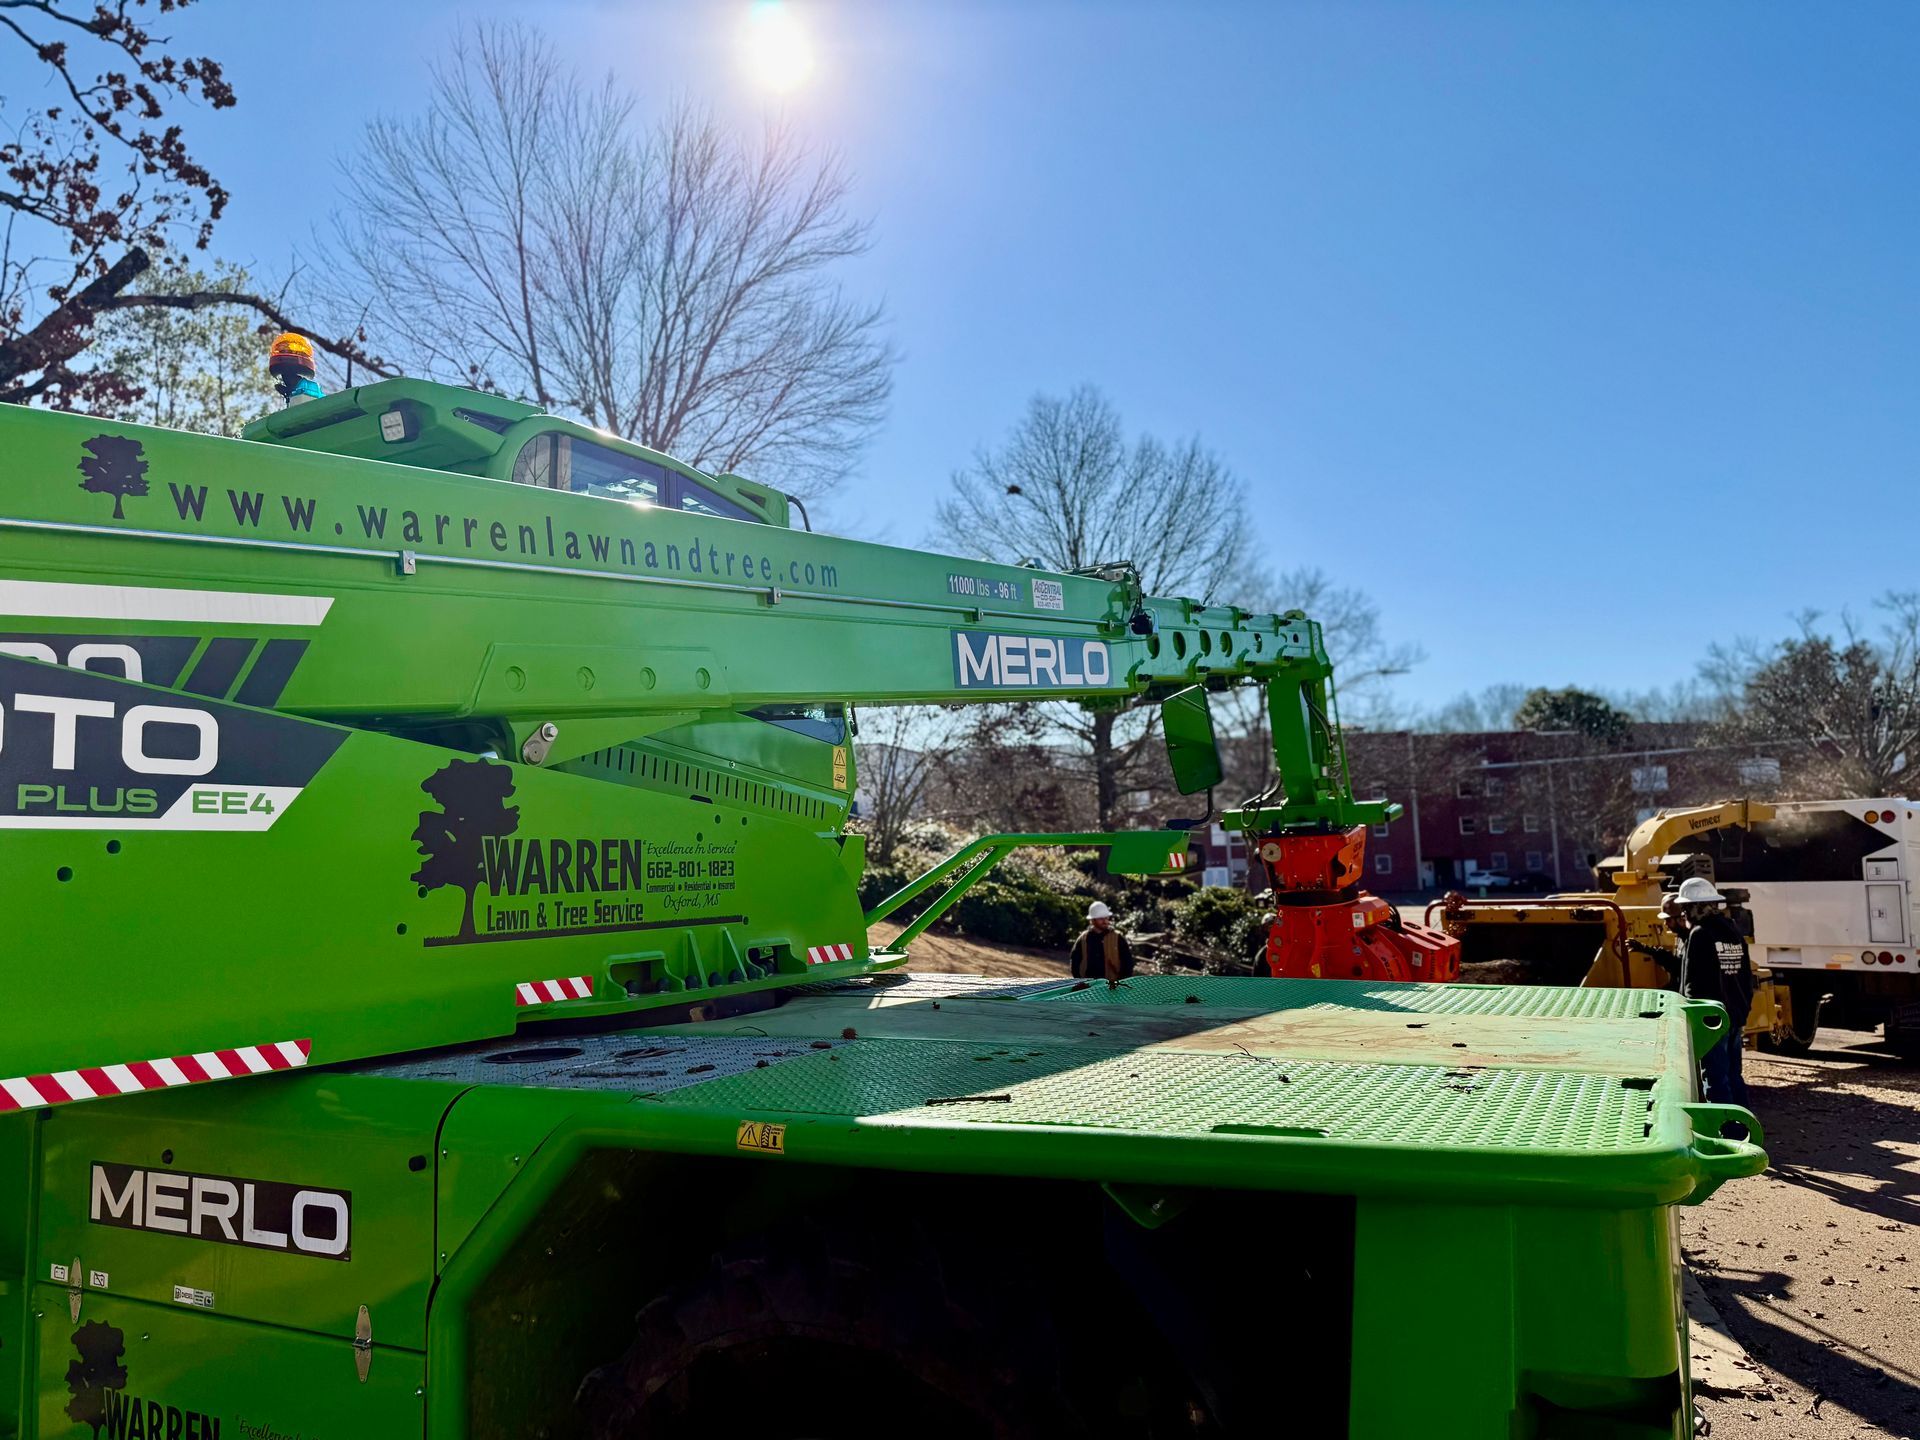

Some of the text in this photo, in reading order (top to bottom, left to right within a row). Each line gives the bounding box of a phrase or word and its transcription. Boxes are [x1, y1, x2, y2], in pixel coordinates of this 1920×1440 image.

[168, 482, 838, 588] www.warrenlawnandtree.com
[948, 575, 975, 595] 11000
[976, 578, 990, 596] lbs
[998, 581, 1009, 599] 96
[1010, 583, 1017, 600] ft
[957, 633, 1109, 686] MERLO
[0, 693, 219, 777] TO
[17, 783, 159, 813] PLUS
[192, 791, 275, 815] EE4
[1688, 814, 1721, 830] Vermeer
[694, 843, 705, 854] In
[484, 838, 642, 897] WARREN
[647, 861, 735, 878] 662-801-1823
[646, 880, 735, 893] Commercial Residential Insured
[487, 898, 644, 931] Lawn & Tree Service
[663, 892, 720, 914] Oxford, MS
[91, 1165, 348, 1256] MERLO
[104, 1387, 220, 1440] WARREN
